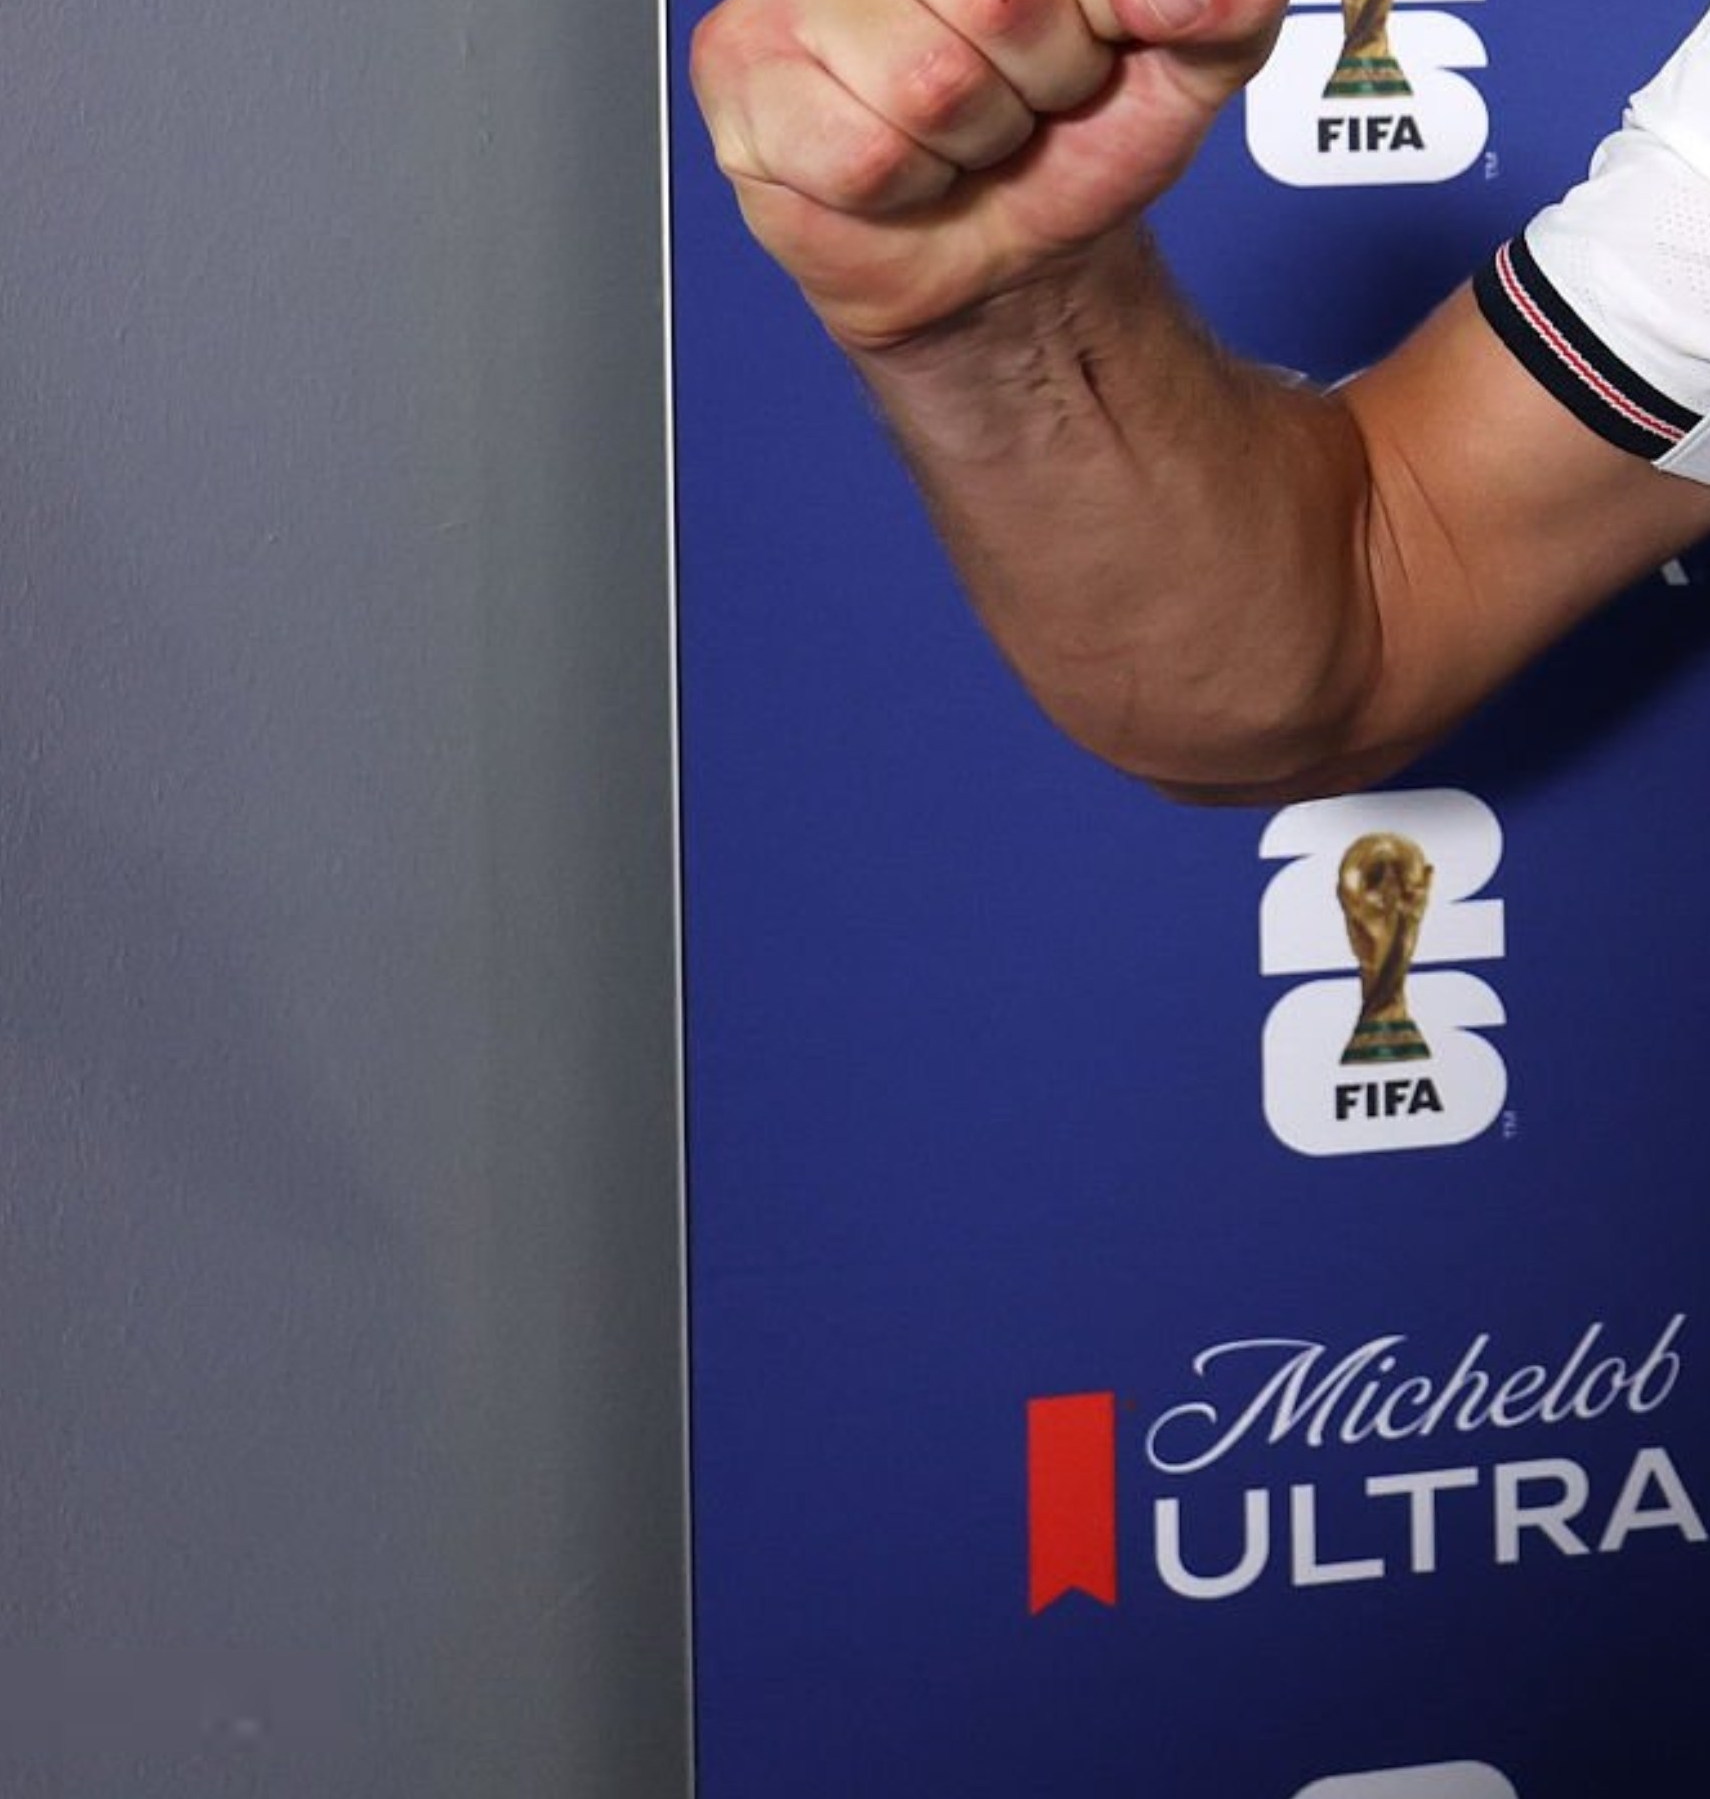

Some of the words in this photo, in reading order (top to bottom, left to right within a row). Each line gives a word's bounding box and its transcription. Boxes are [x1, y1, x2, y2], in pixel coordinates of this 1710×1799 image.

[1318, 116, 1424, 152] FIFA
[1336, 1078, 1443, 1120] FIFA
[1147, 1314, 1684, 1473] Michelob
[1155, 1448, 1706, 1598] ULTRA
